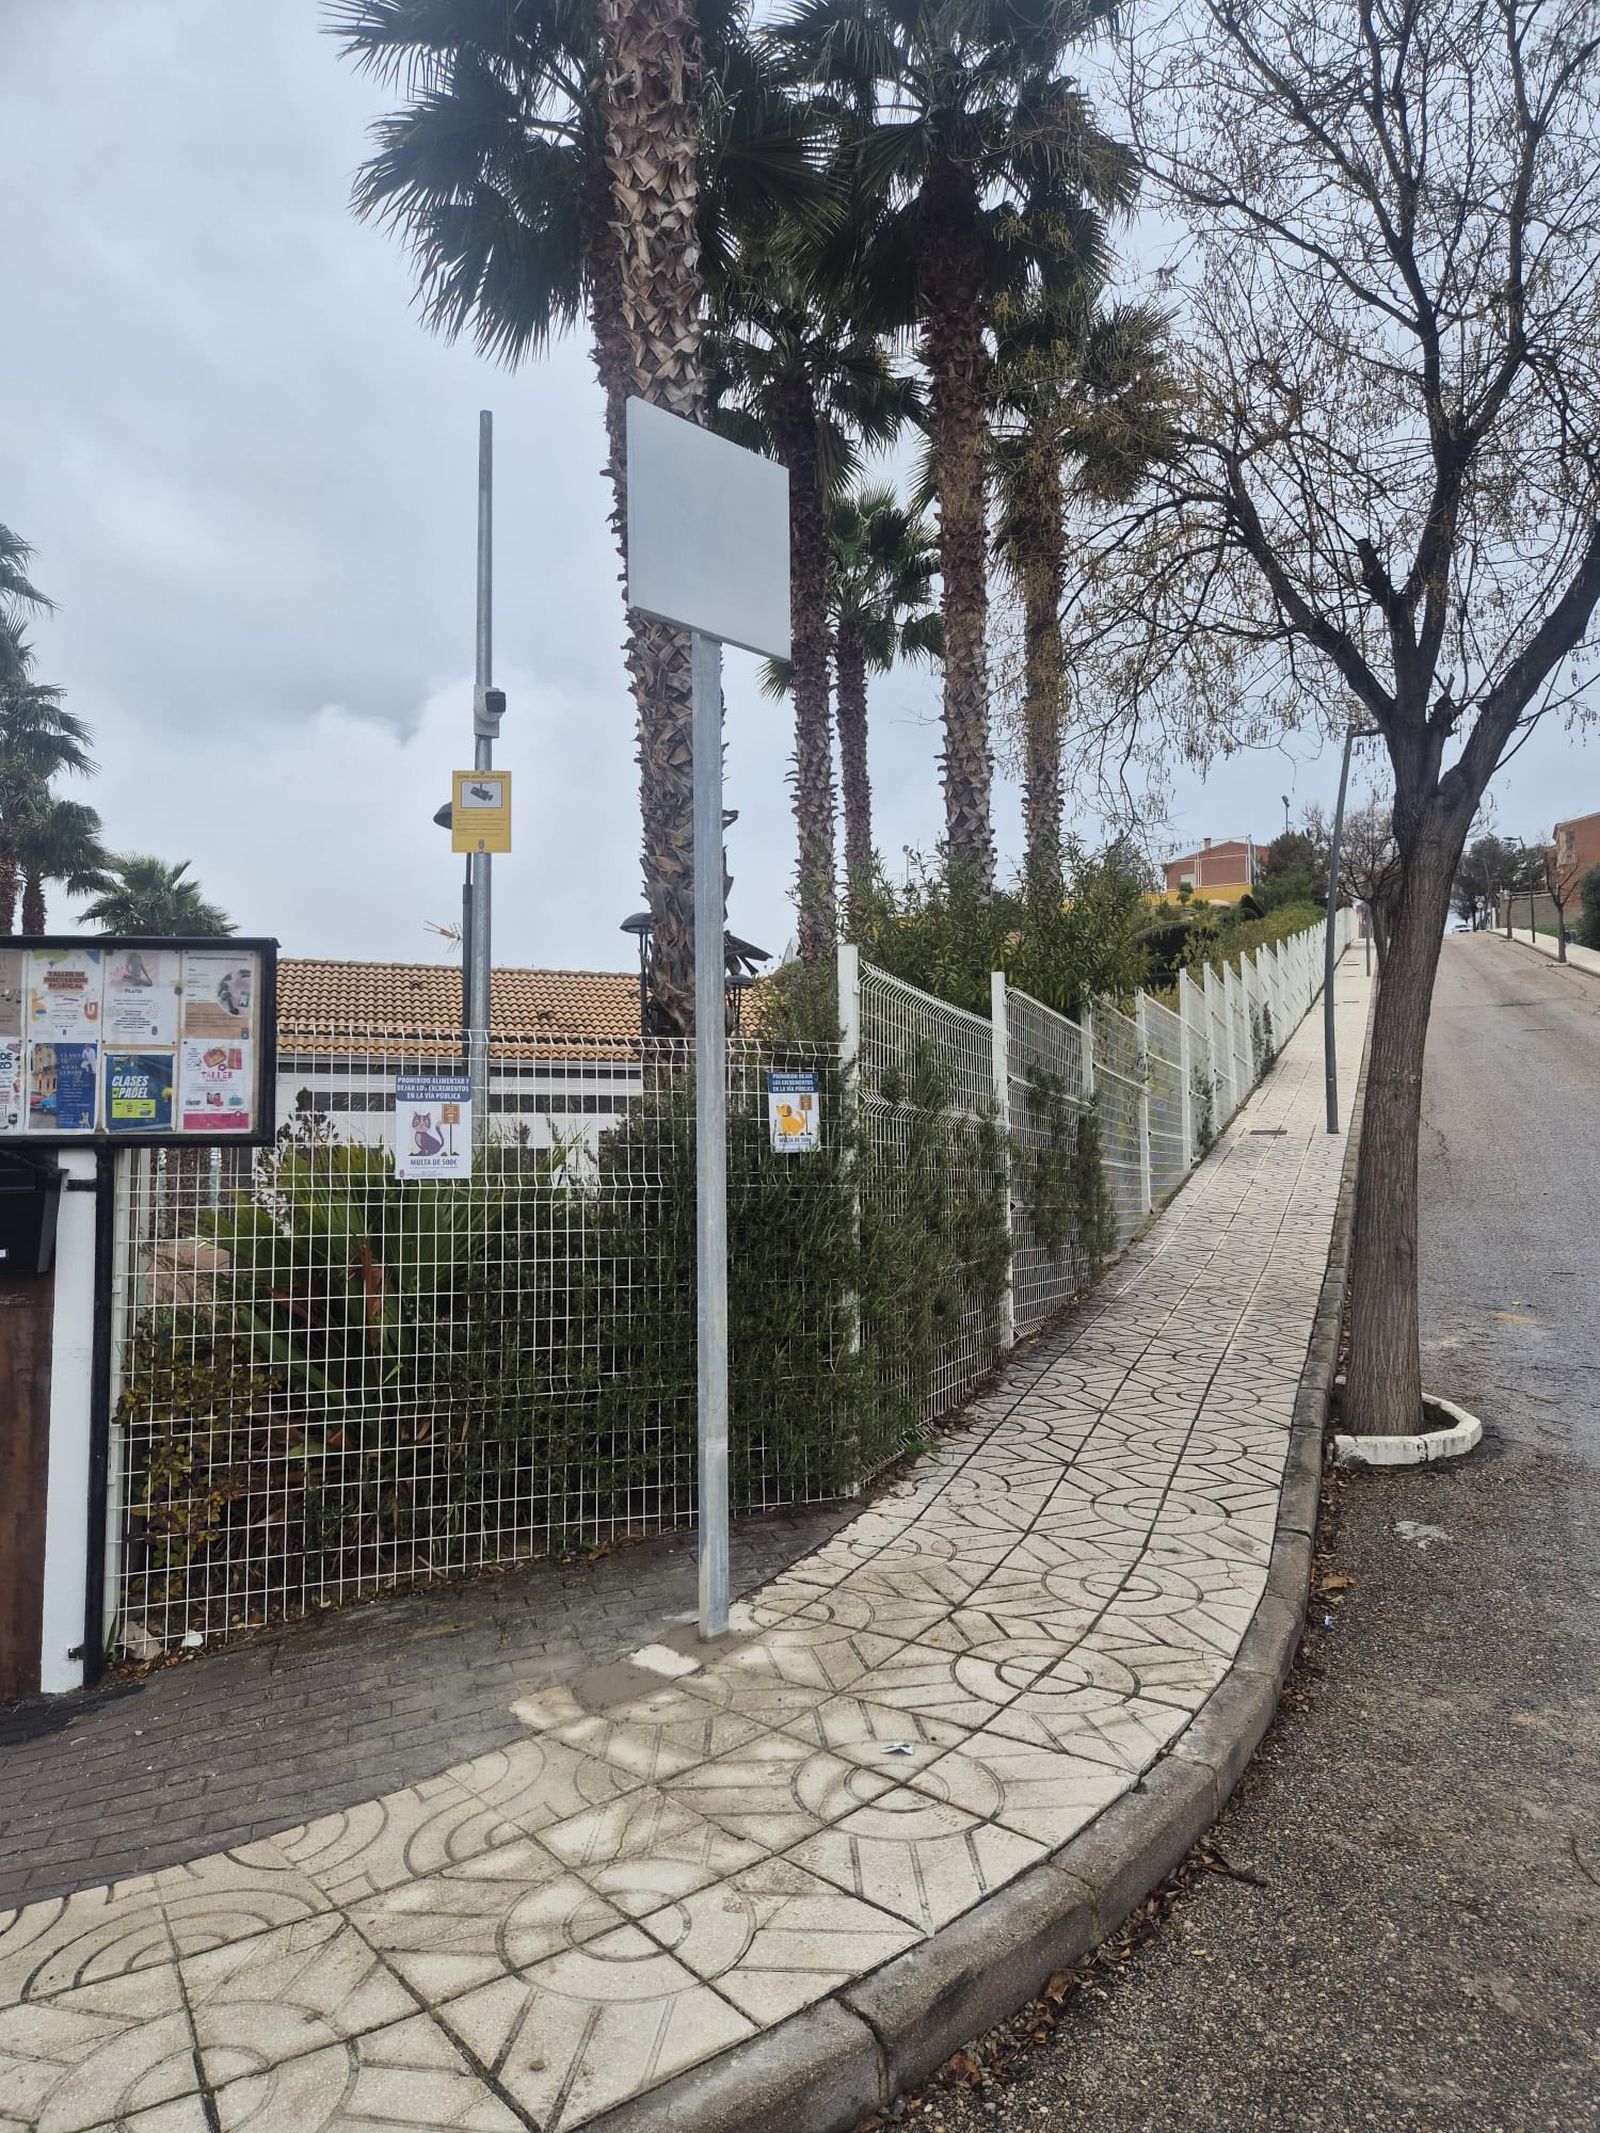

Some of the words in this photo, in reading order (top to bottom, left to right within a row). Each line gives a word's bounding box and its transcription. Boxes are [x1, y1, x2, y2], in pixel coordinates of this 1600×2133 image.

[112, 1075, 149, 1087] CLASES
[118, 1087, 148, 1098] PADEL
[410, 1158, 431, 1166] MULTA
[432, 1158, 440, 1166] DE
